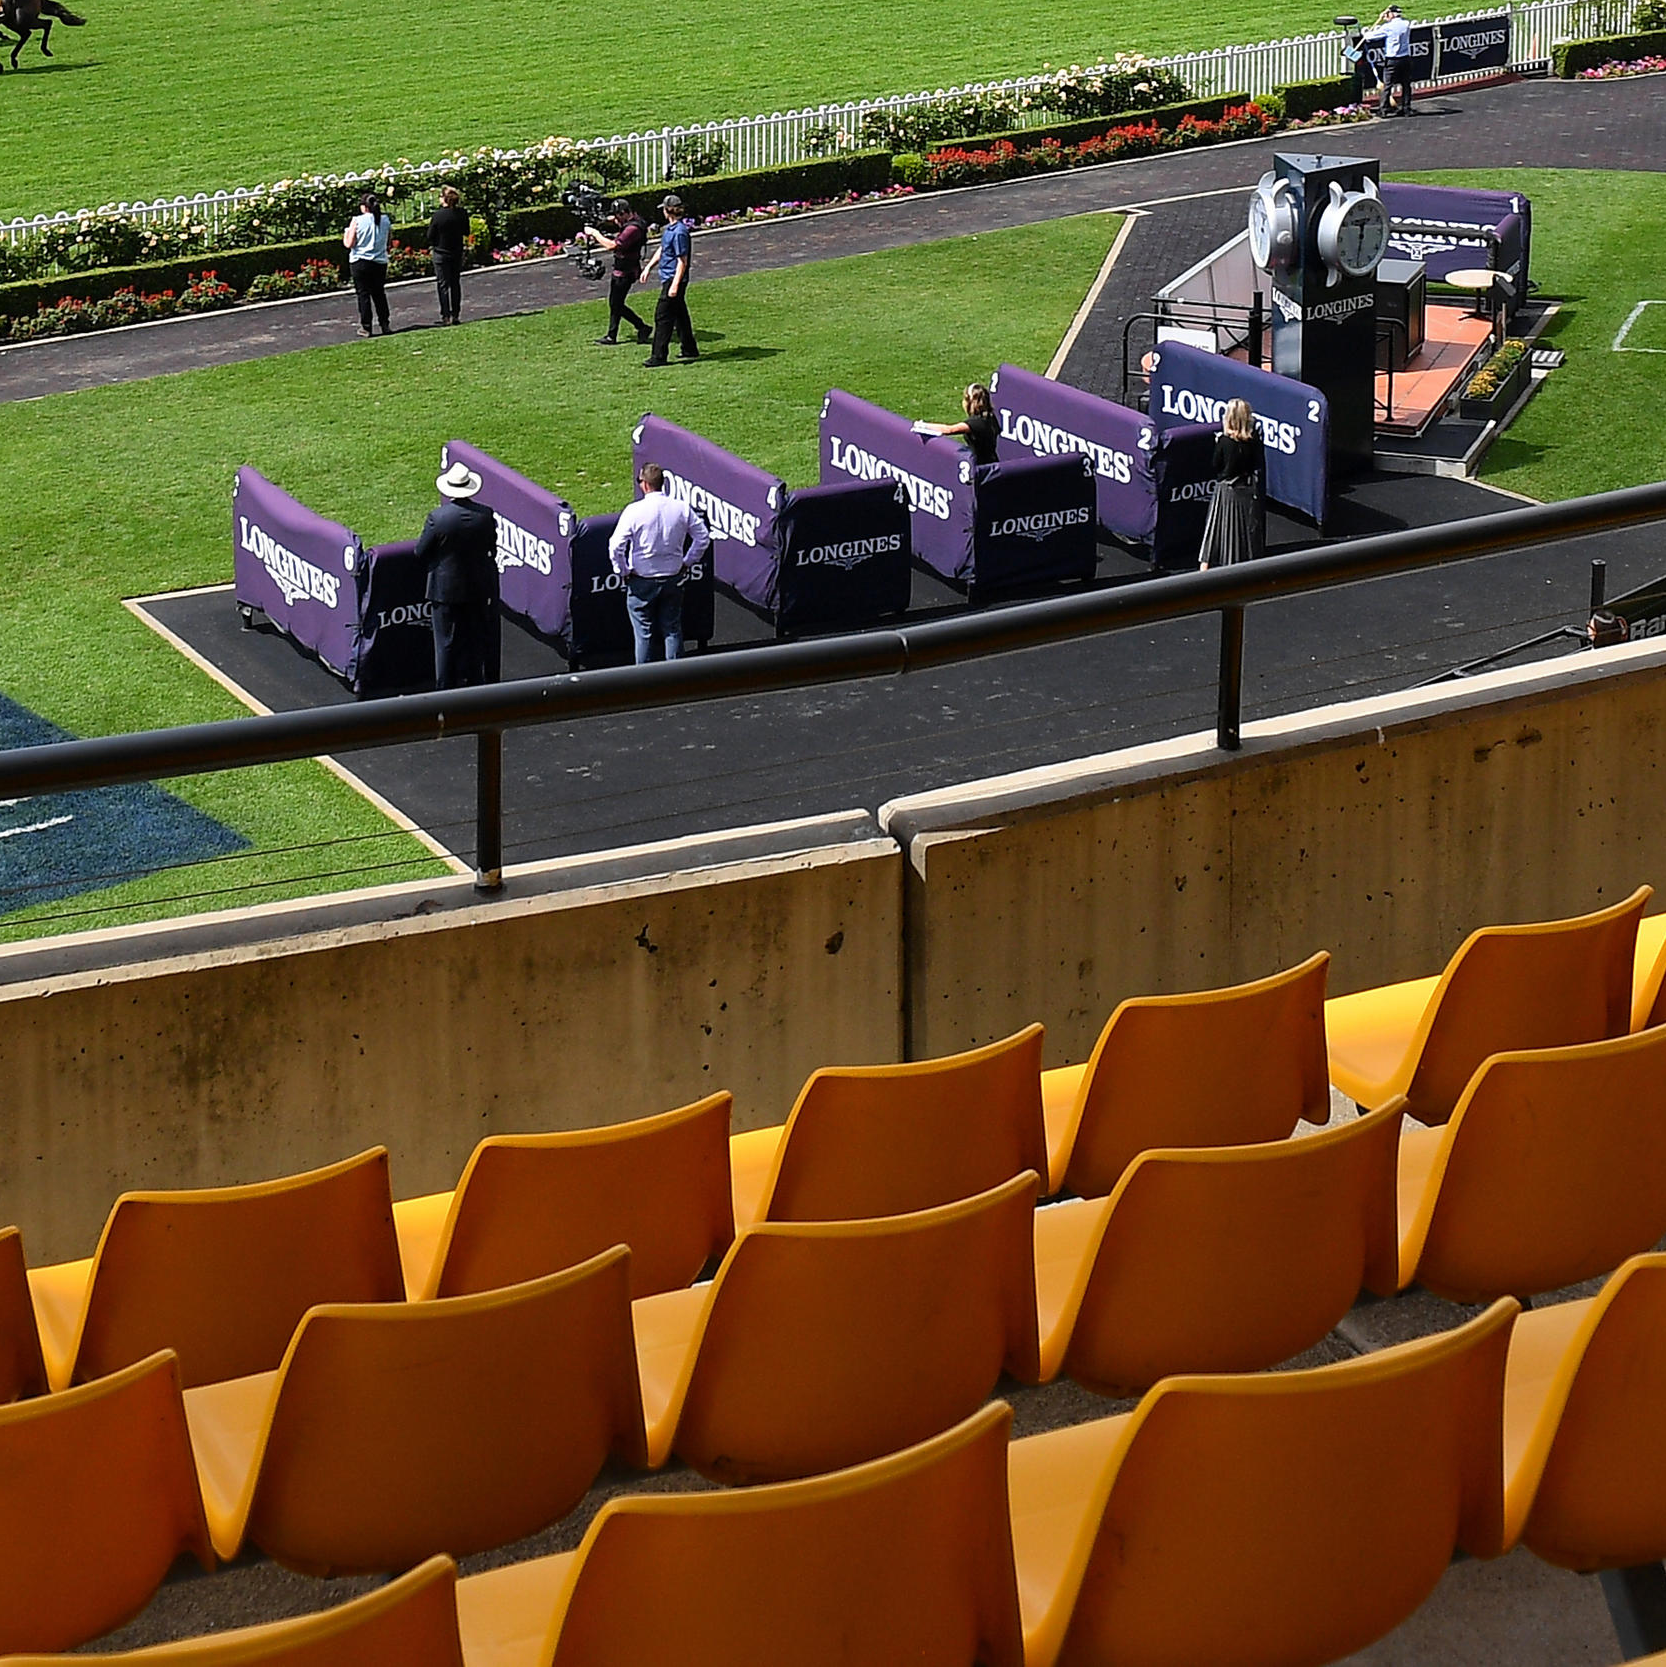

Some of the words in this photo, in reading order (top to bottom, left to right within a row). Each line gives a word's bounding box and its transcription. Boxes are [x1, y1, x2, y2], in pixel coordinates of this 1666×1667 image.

[1443, 29, 1507, 53] LONGINES
[1510, 197, 1520, 214] 1
[1306, 292, 1374, 321] LONGINES
[1308, 400, 1320, 423] 2
[1000, 408, 1134, 484] LONGINES
[1137, 428, 1152, 451] 2
[830, 436, 952, 520] LONGINES
[958, 460, 971, 484] 3
[1083, 458, 1093, 477] 3
[766, 486, 778, 509] 4
[893, 487, 904, 504] 4
[662, 470, 761, 547] ONGINES
[558, 512, 571, 536] 5
[989, 507, 1090, 537] LONGINES
[344, 546, 356, 571] 6
[797, 534, 902, 566] LONGINES
[240, 516, 341, 609] LONGINES
